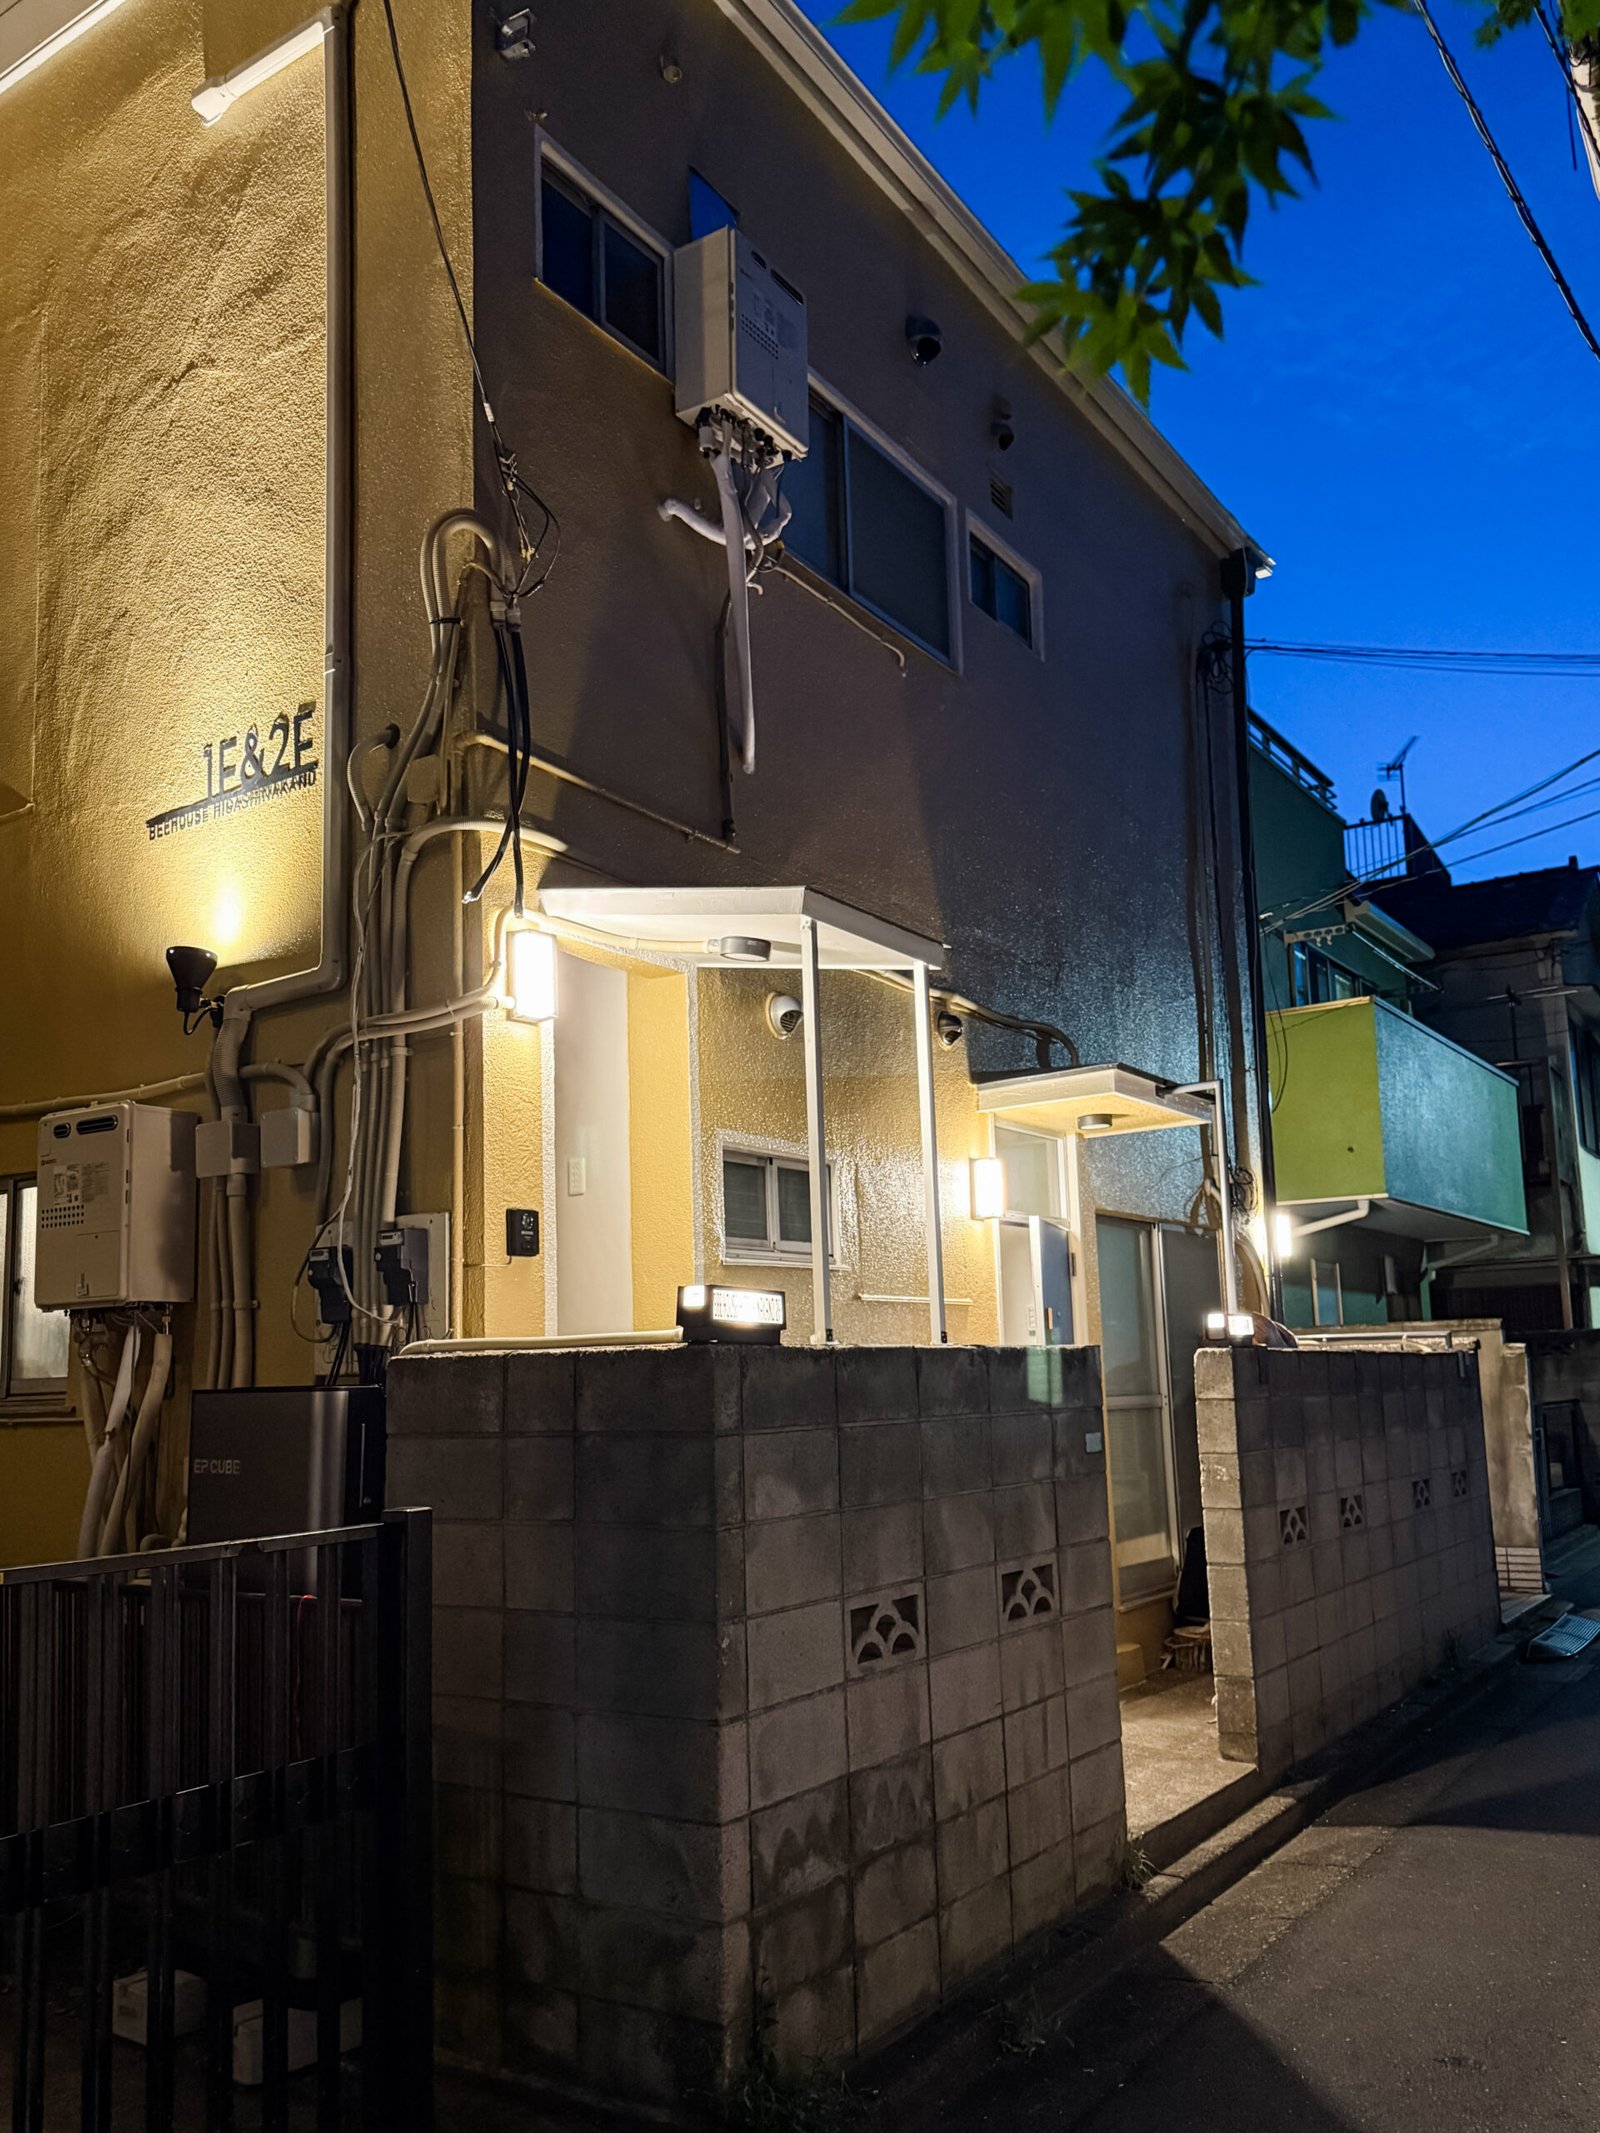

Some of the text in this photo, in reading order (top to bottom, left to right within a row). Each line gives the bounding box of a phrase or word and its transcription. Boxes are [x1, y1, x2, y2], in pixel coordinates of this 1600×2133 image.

[148, 809, 208, 840] BEEHOUSE
[193, 1458, 241, 1475] EP CUBE
